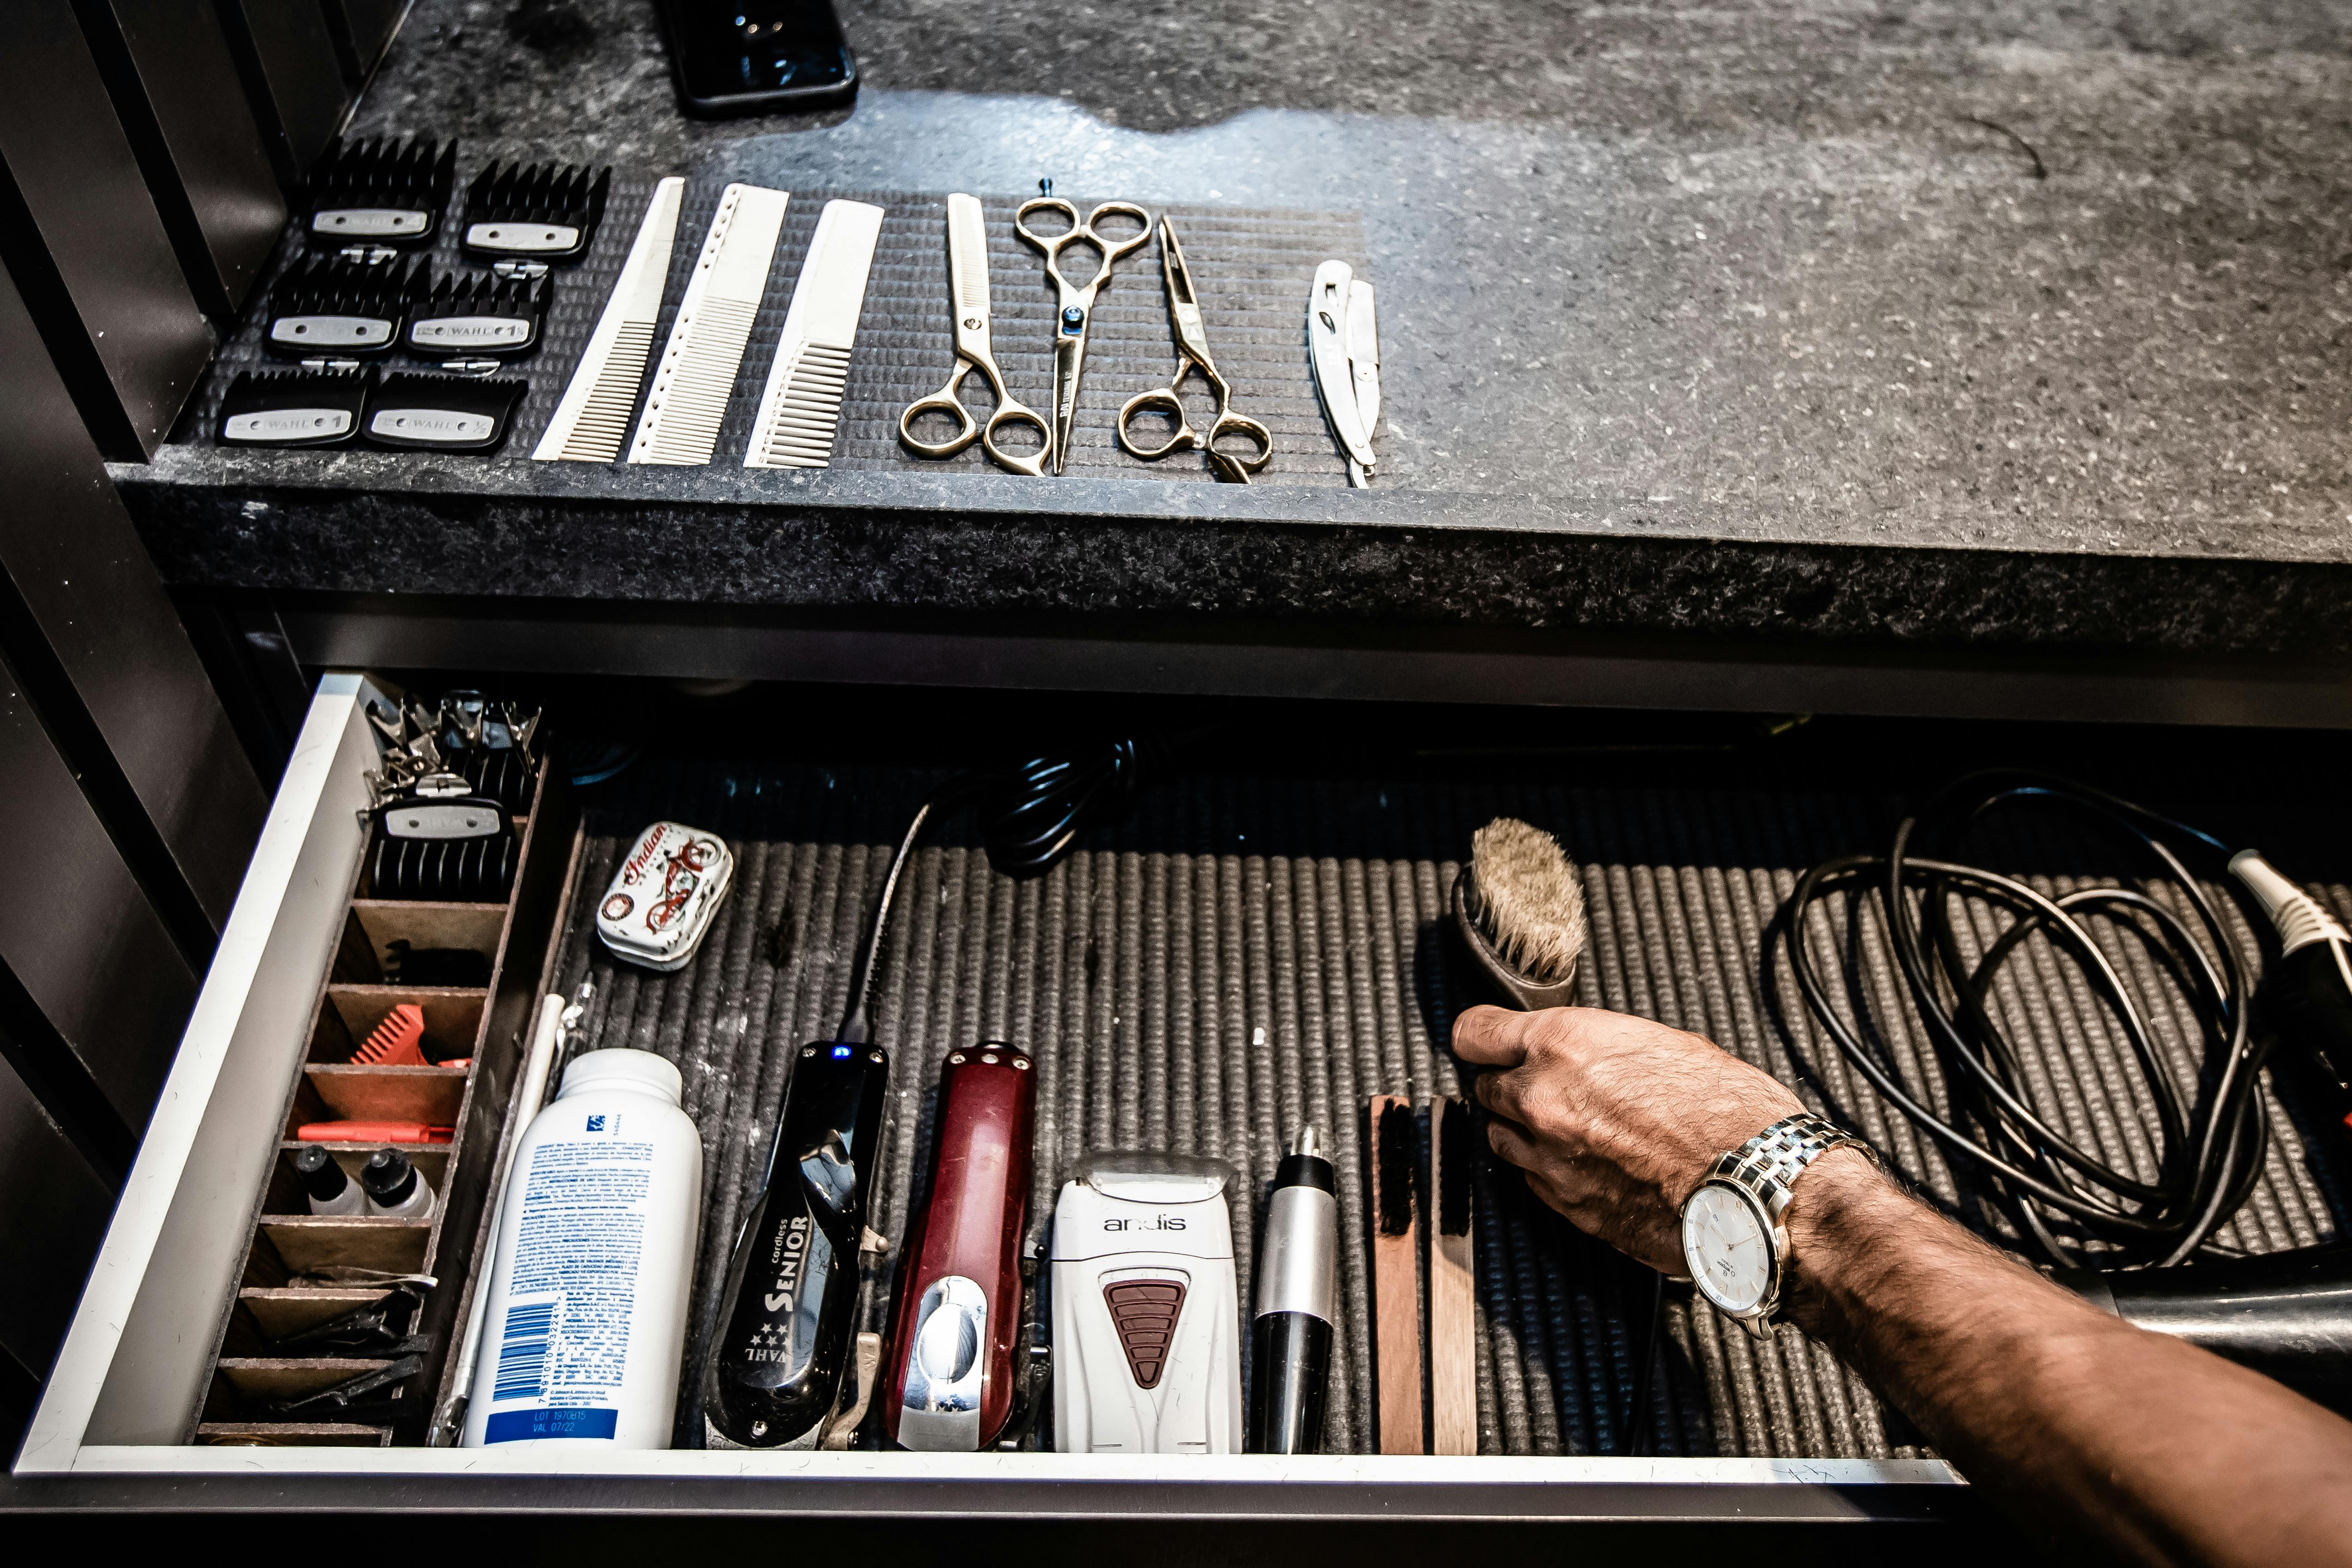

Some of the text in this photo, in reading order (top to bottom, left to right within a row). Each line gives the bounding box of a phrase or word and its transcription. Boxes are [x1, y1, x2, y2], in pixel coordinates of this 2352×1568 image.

[624, 823, 667, 885] Indian
[772, 1219, 788, 1263] cordless
[765, 1216, 808, 1312] SENIOR
[745, 1348, 791, 1361] WAHL
[534, 1422, 575, 1432] VAL 07/22
[535, 1412, 549, 1421] LOT
